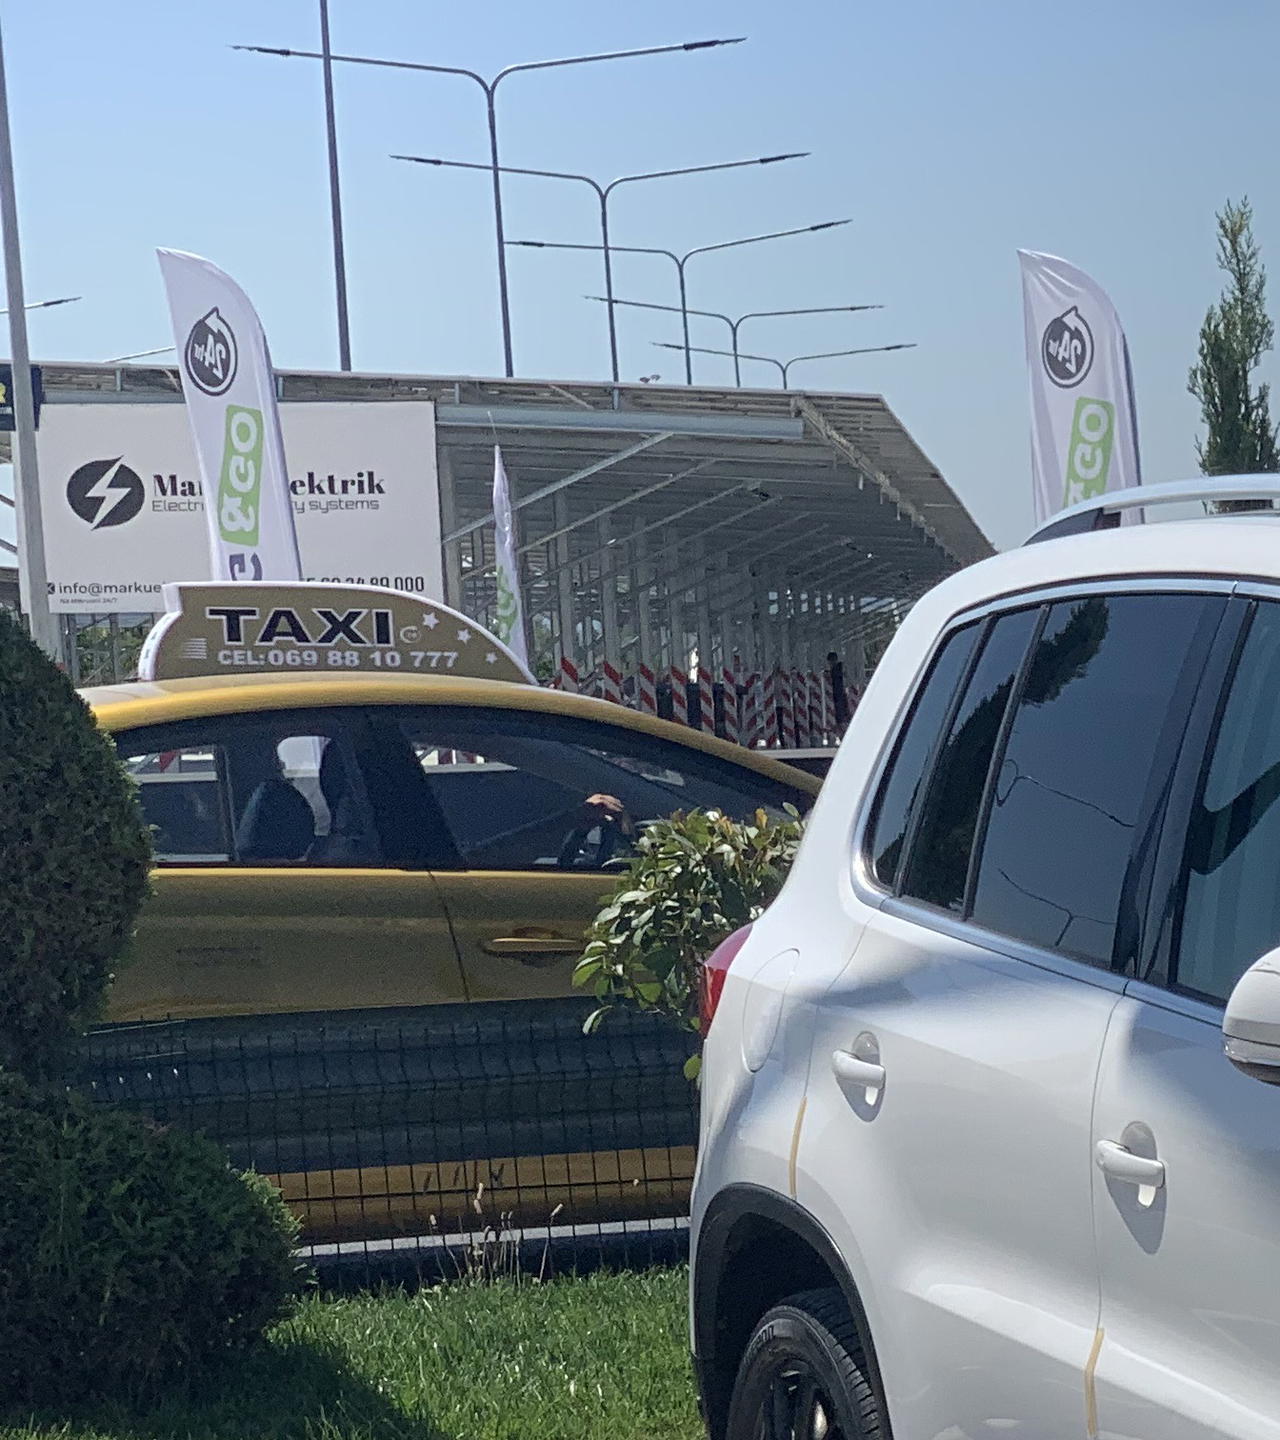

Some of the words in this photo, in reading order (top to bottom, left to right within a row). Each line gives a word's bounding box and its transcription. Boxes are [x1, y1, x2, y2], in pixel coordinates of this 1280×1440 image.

[309, 499, 380, 514] systems
[58, 579, 165, 597] info@markue
[206, 607, 396, 647] TAXI
[327, 650, 361, 667] 88
[369, 650, 401, 667] 10
[410, 651, 459, 668] 777
